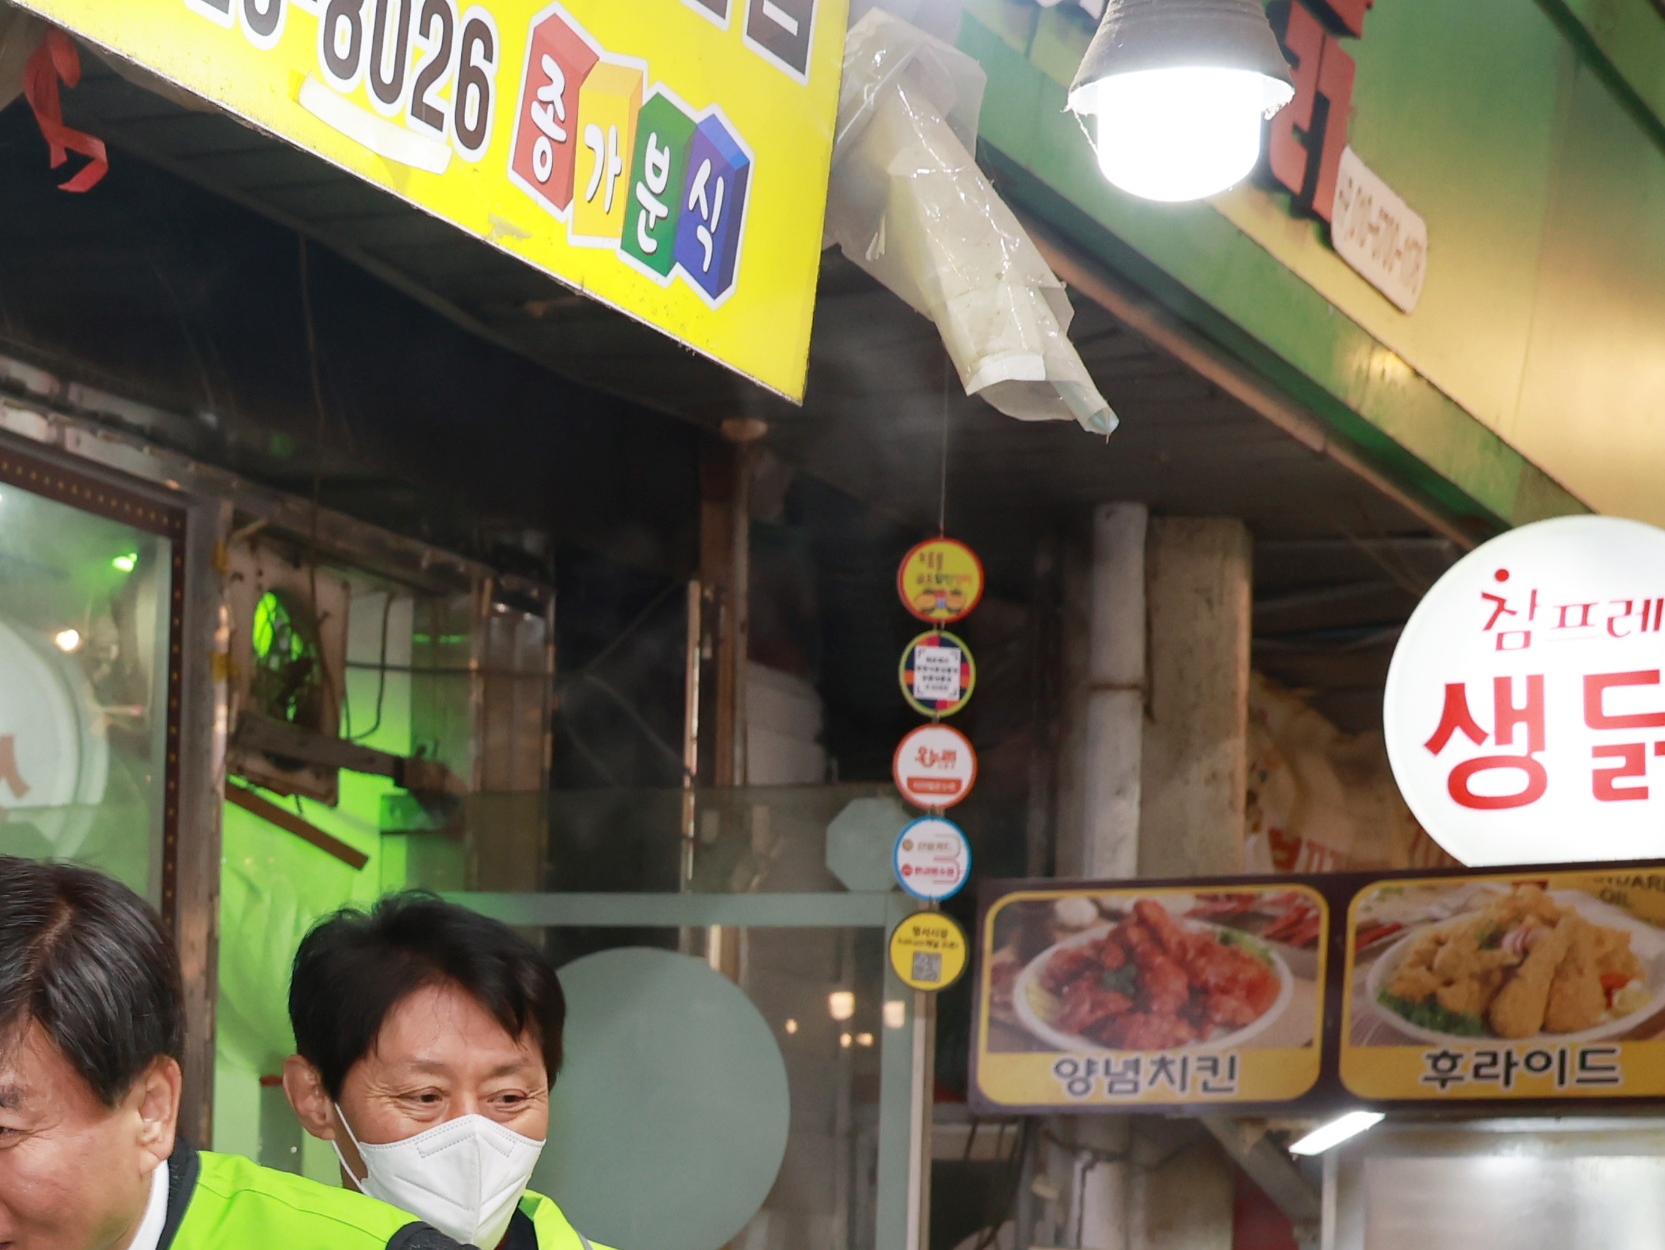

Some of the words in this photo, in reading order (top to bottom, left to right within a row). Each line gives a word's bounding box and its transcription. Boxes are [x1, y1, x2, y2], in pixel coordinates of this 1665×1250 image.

[531, 53, 725, 273] 종가분식
[1054, 1054, 1237, 1097] 양념치킨
[1423, 1048, 1621, 1087] 후라이드
